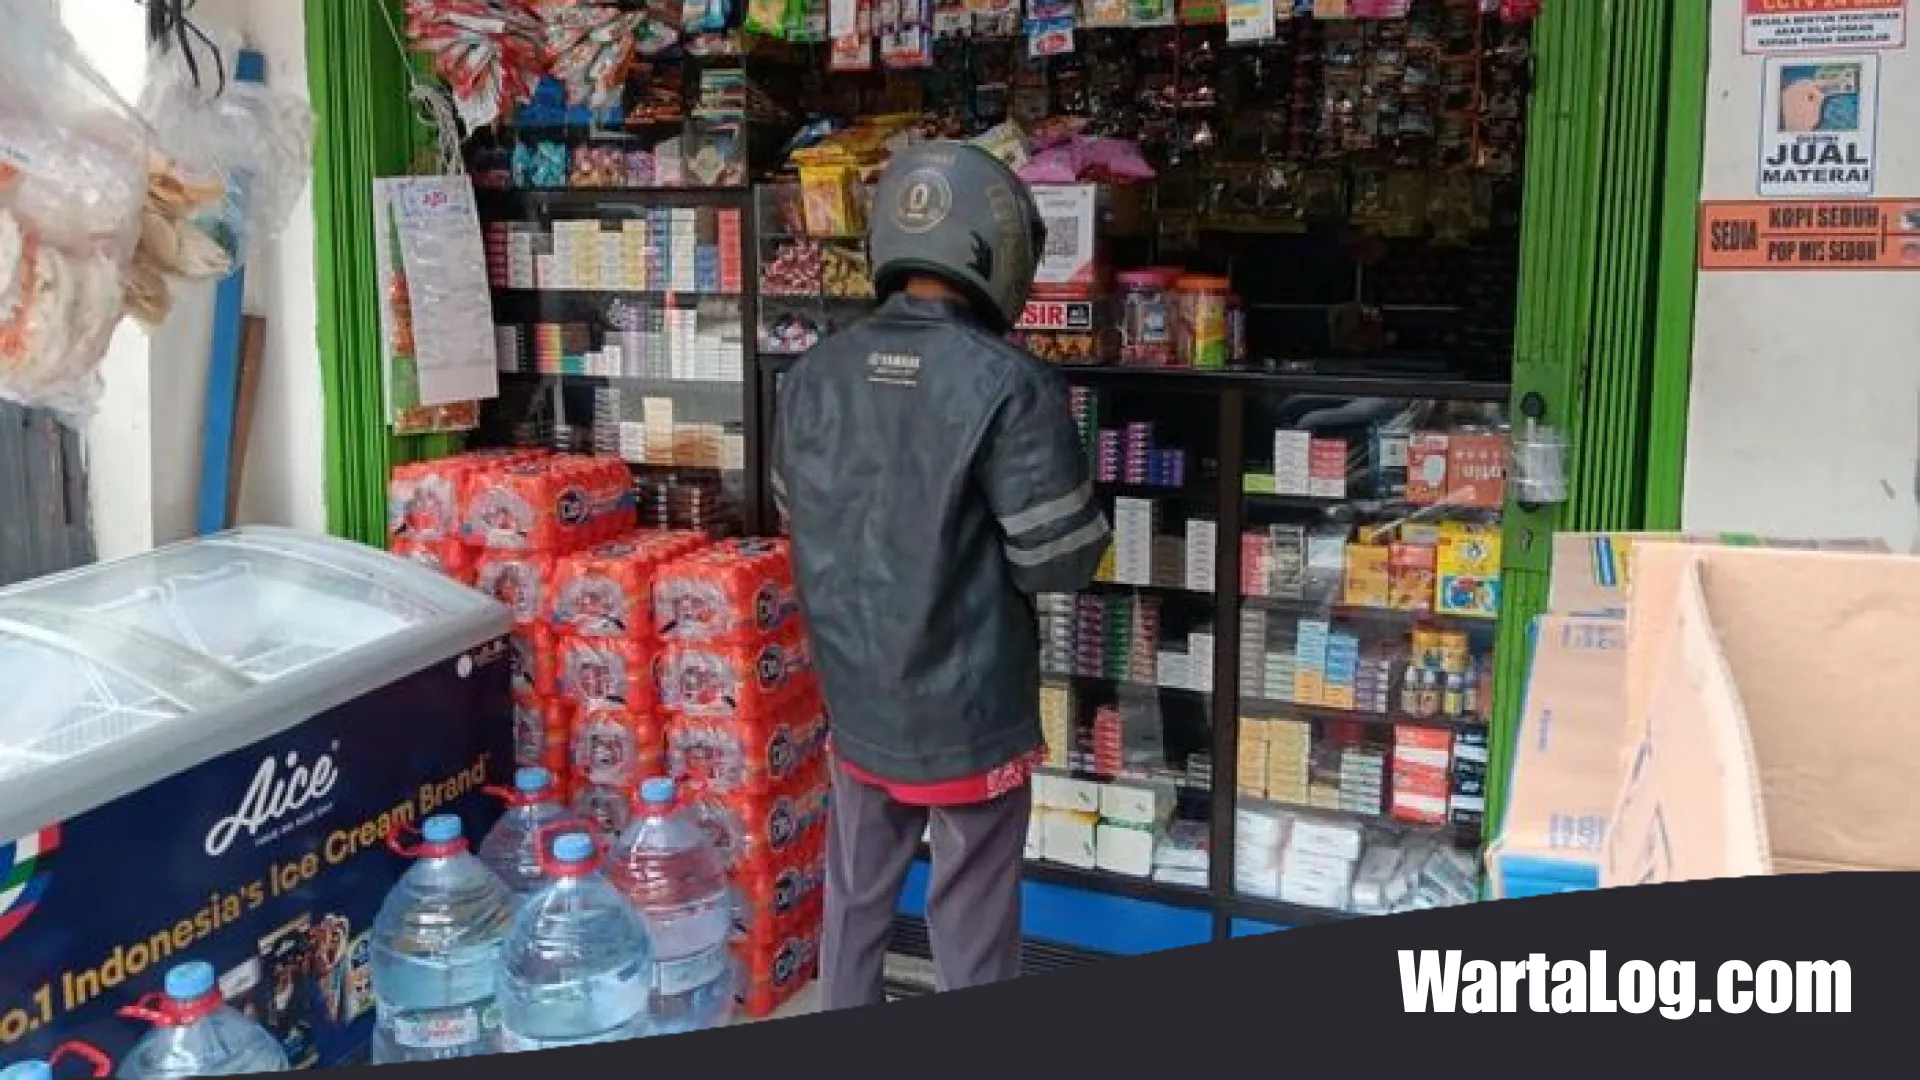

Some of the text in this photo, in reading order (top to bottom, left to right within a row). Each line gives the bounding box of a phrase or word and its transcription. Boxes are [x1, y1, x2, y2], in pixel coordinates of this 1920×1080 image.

[1766, 143, 1868, 165] JUAL
[1763, 168, 1869, 183] MATERAI
[1769, 206, 1879, 228] KOPI SEDUH
[1711, 219, 1758, 252] SEDIA
[1767, 241, 1797, 261] POP
[1024, 303, 1065, 326] SIR
[205, 750, 339, 856] Aice
[0, 984, 53, 1043] o.1
[62, 880, 265, 1010] Indonesia's
[270, 852, 320, 896] Ice
[324, 799, 415, 865] Cream
[419, 751, 487, 814] Brand
